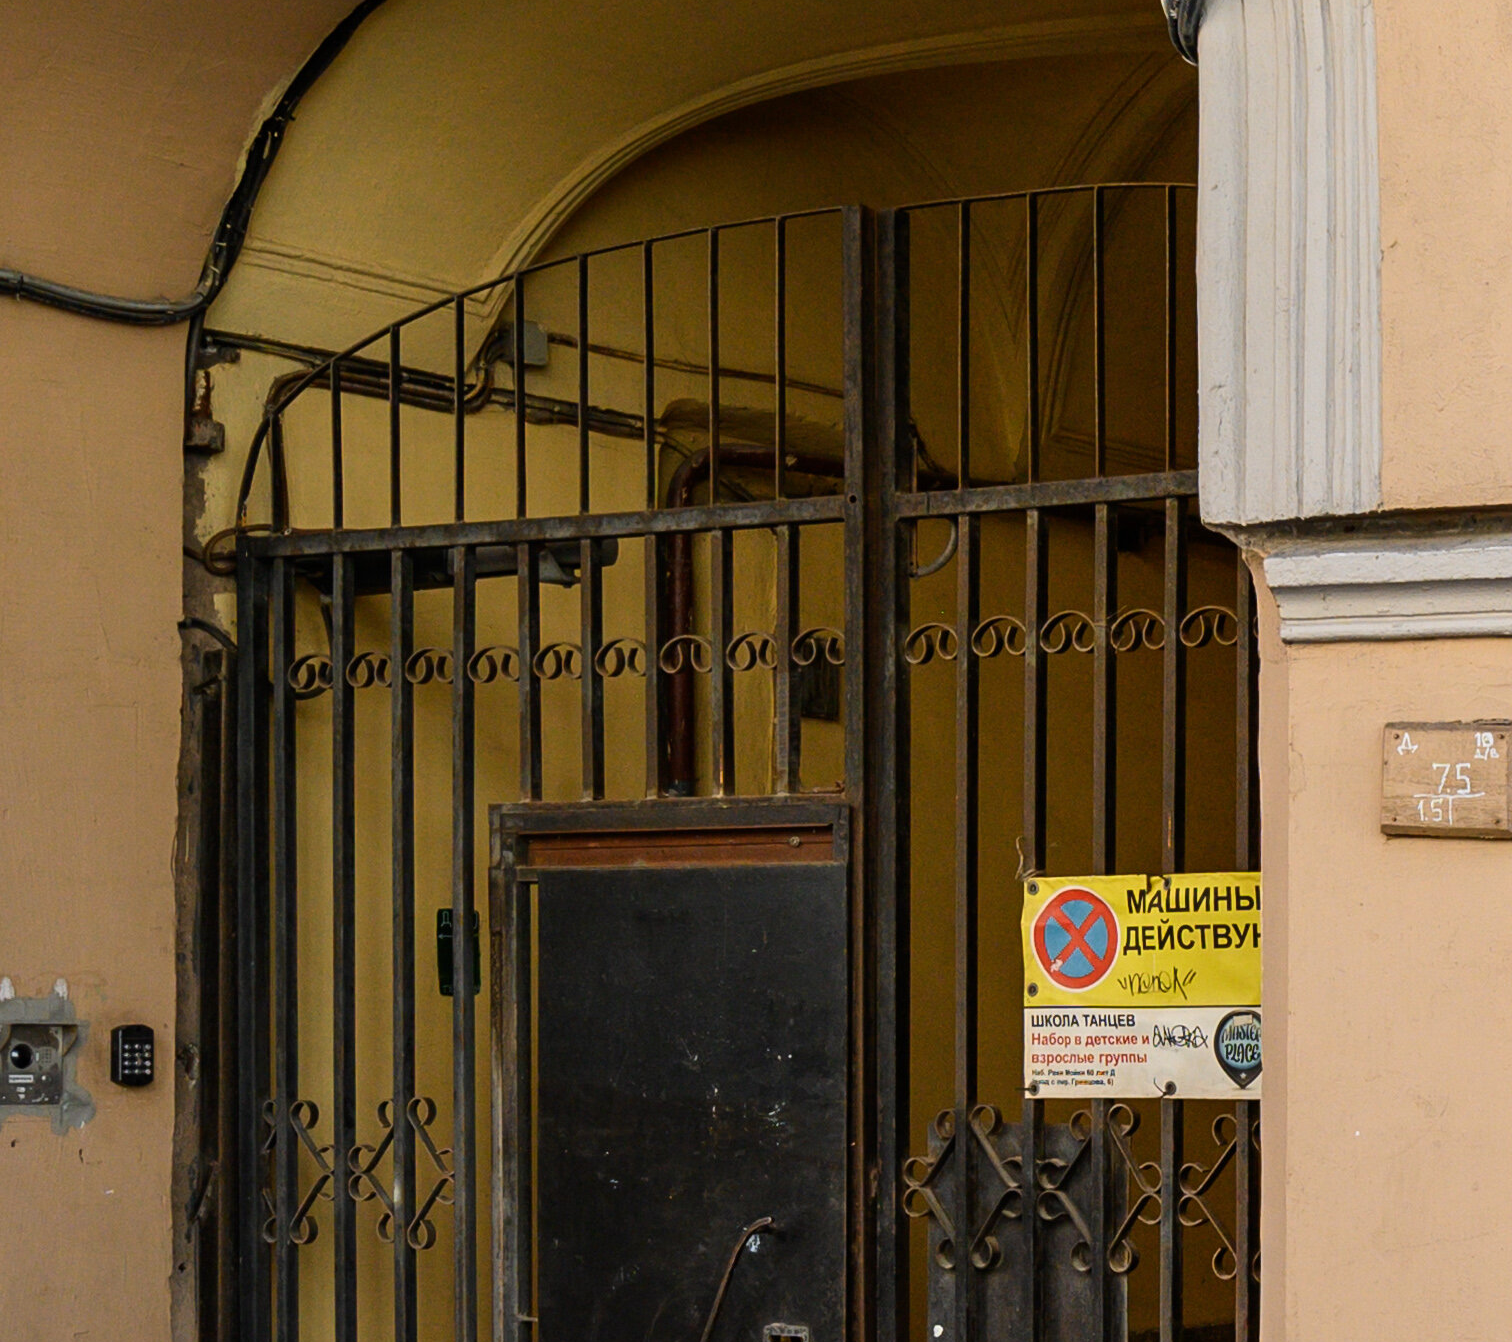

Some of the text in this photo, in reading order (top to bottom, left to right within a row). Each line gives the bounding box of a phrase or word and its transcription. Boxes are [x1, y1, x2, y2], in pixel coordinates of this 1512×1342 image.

[1126, 885, 1261, 915] МАШИНЫ
[1031, 1014, 1136, 1029] ШКОЛА ТАНЦЕВ
[1031, 1032, 1072, 1048] Набор
[1074, 1035, 1082, 1045] в
[1085, 1034, 1138, 1048] детские
[1141, 1035, 1150, 1045] и
[1031, 1052, 1148, 1066] взрослые группы
[1224, 1043, 1261, 1063] PLACE
